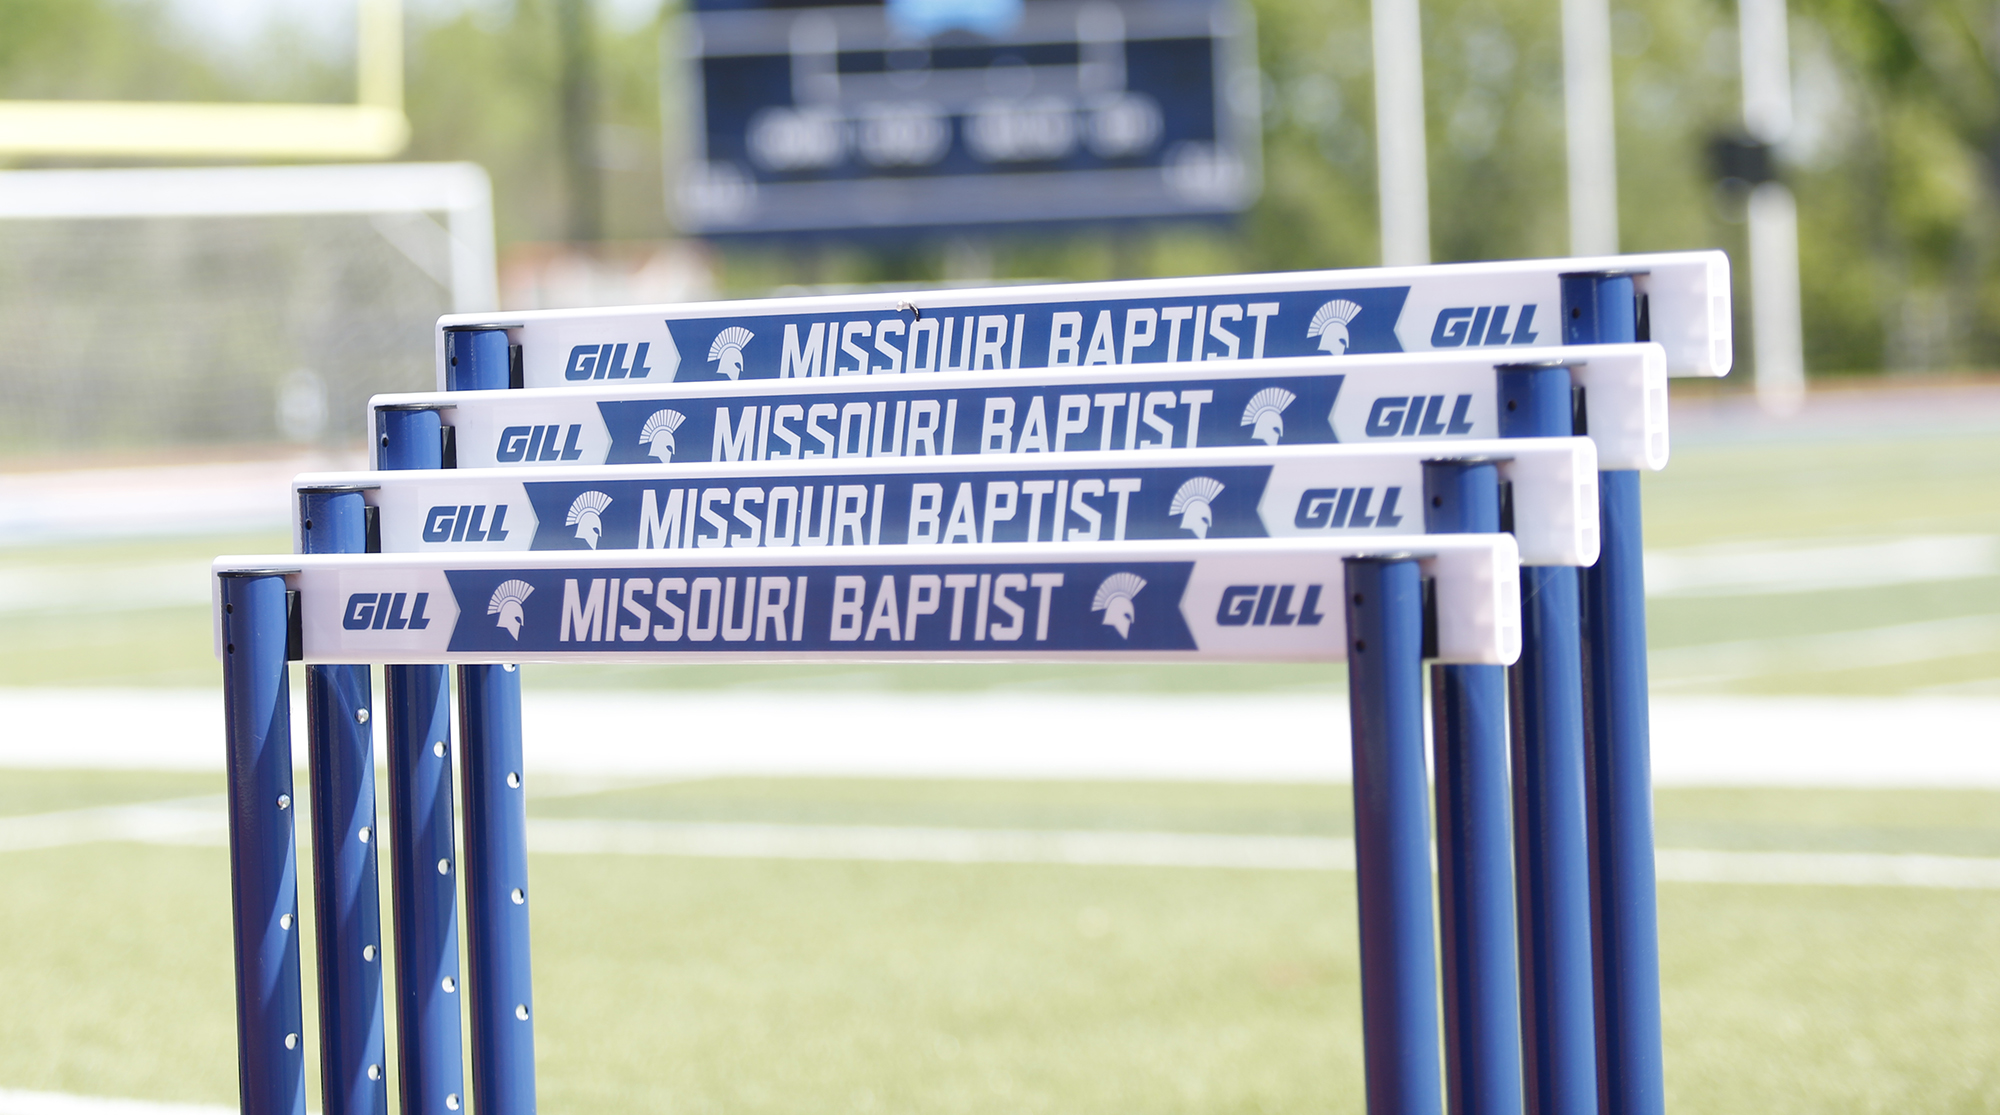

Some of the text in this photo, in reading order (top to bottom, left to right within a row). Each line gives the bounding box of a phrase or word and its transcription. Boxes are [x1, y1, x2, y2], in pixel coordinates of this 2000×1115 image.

[782, 304, 1280, 377] MISSOURI BAPTIST
[1431, 304, 1540, 347] GILL
[564, 342, 652, 381] GILL
[714, 391, 1213, 461] MISSOURI BAPTIST
[1365, 395, 1474, 437] GILL
[496, 425, 583, 463] GILL
[422, 504, 510, 542] GILL
[640, 478, 1141, 549] MISSOURI BAPTIST
[1294, 486, 1403, 529] GILL
[343, 592, 431, 631] GILL
[560, 573, 1064, 642] MISSOURI BAPTIST
[1216, 584, 1324, 626] GILL
